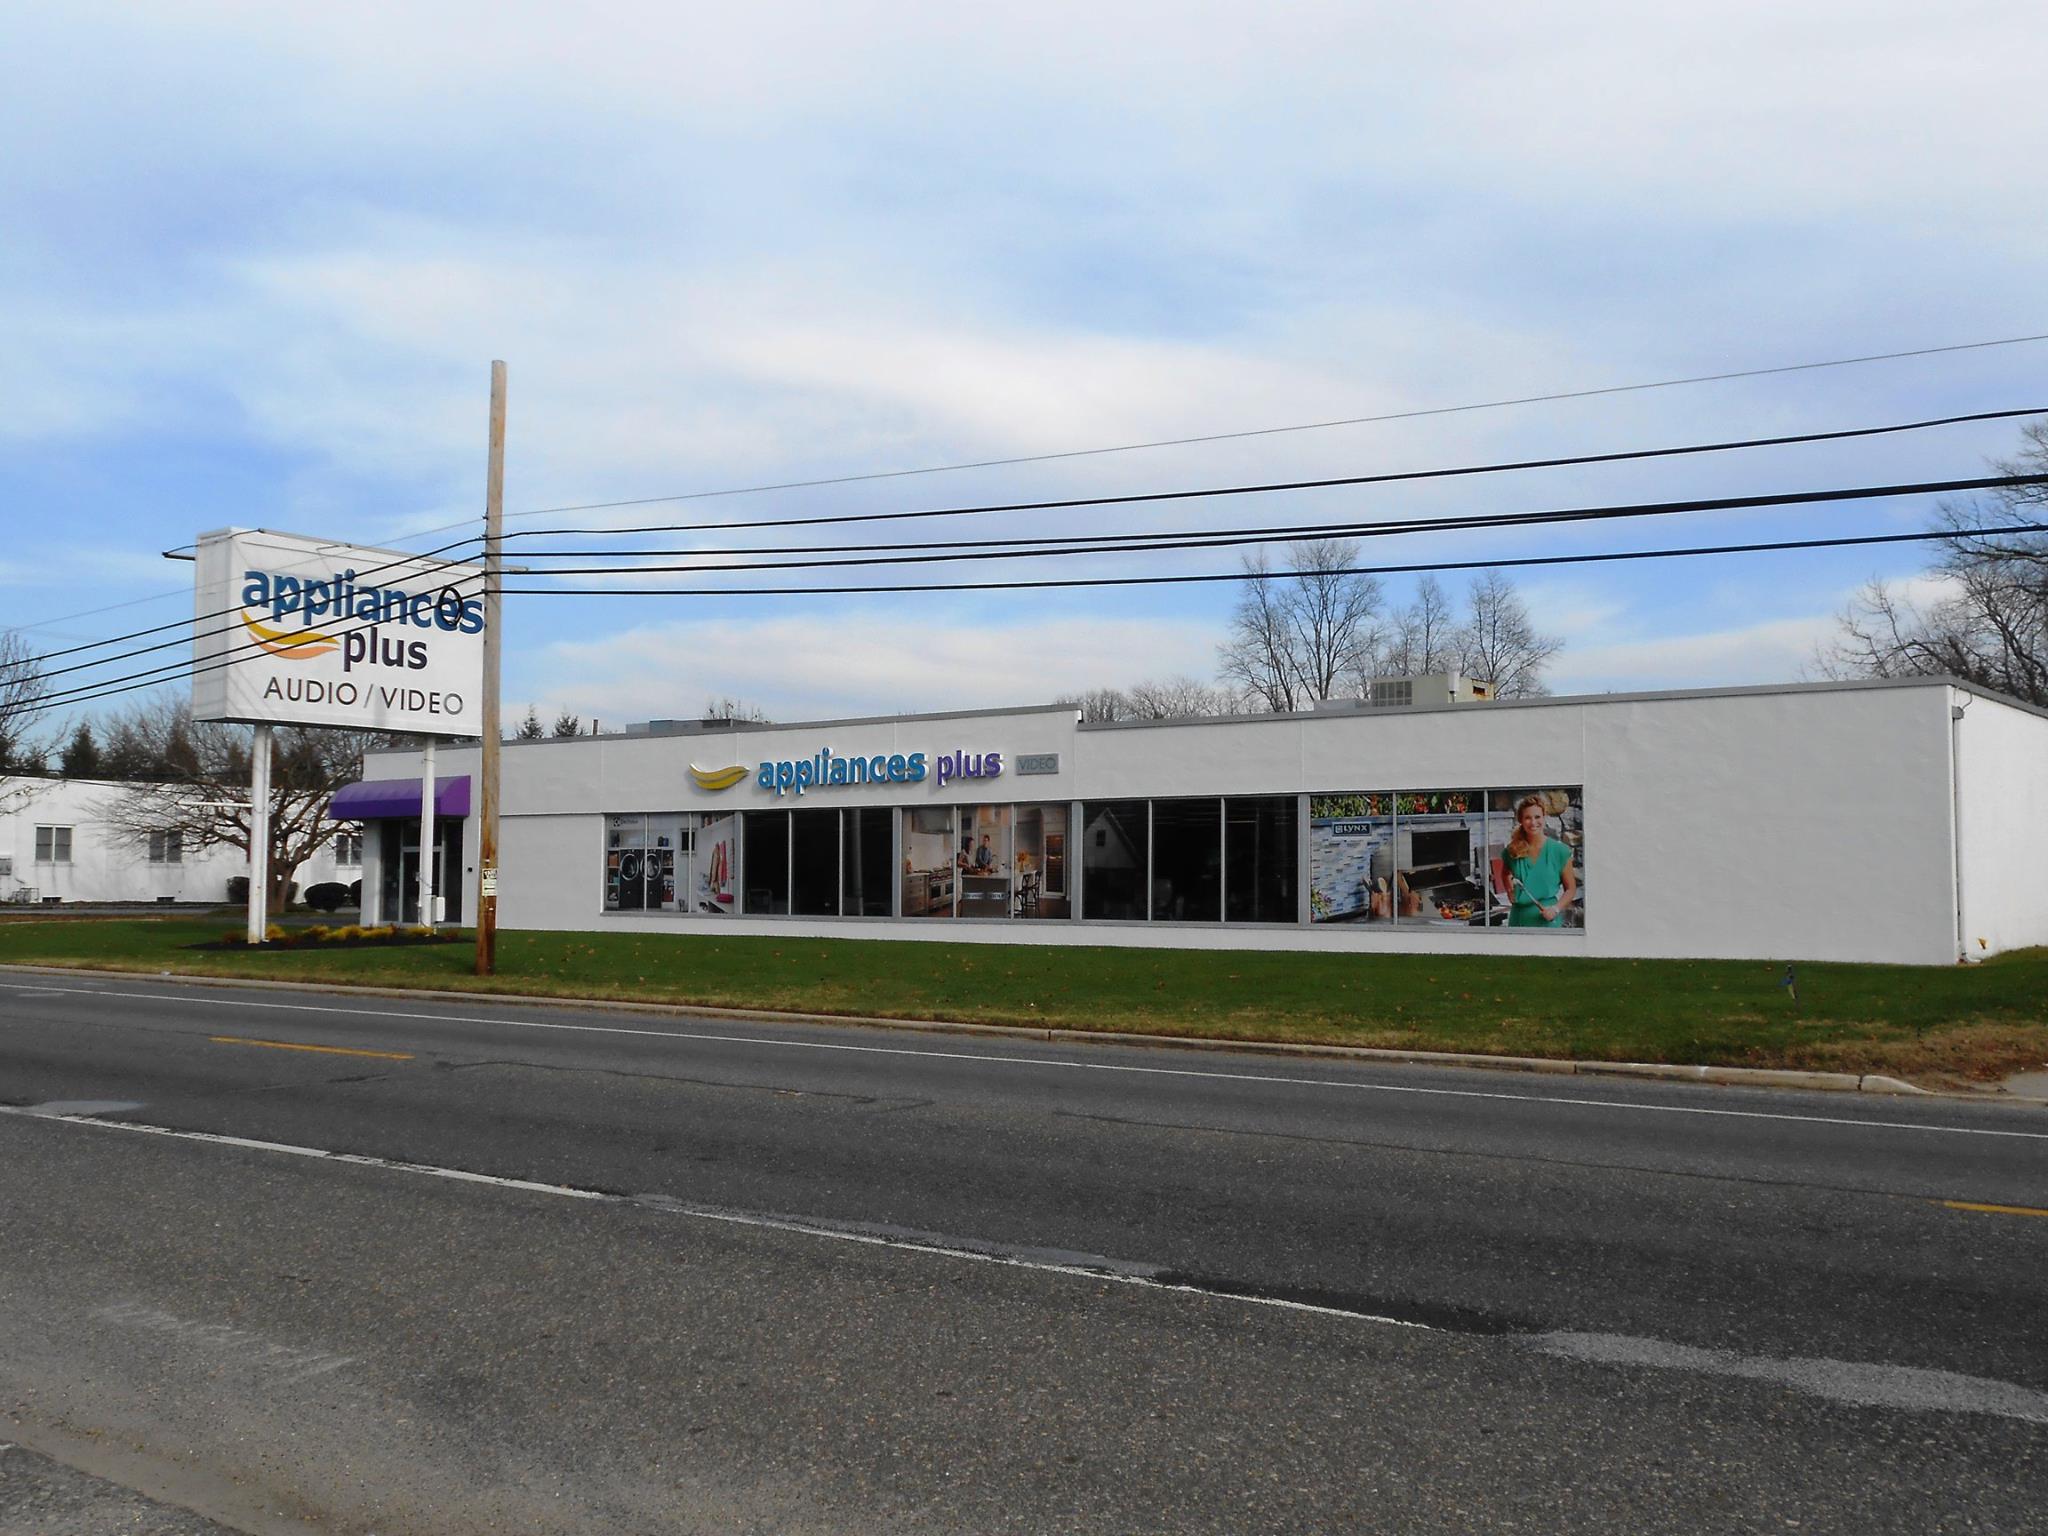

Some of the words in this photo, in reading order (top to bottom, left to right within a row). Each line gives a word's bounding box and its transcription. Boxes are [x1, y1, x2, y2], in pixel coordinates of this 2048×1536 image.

[241, 568, 484, 634] appliances
[343, 626, 428, 672] plus
[758, 747, 927, 795] appliances
[937, 750, 1002, 787] plus
[1017, 757, 1057, 771] VIDEO
[1343, 824, 1368, 832] LYNX
